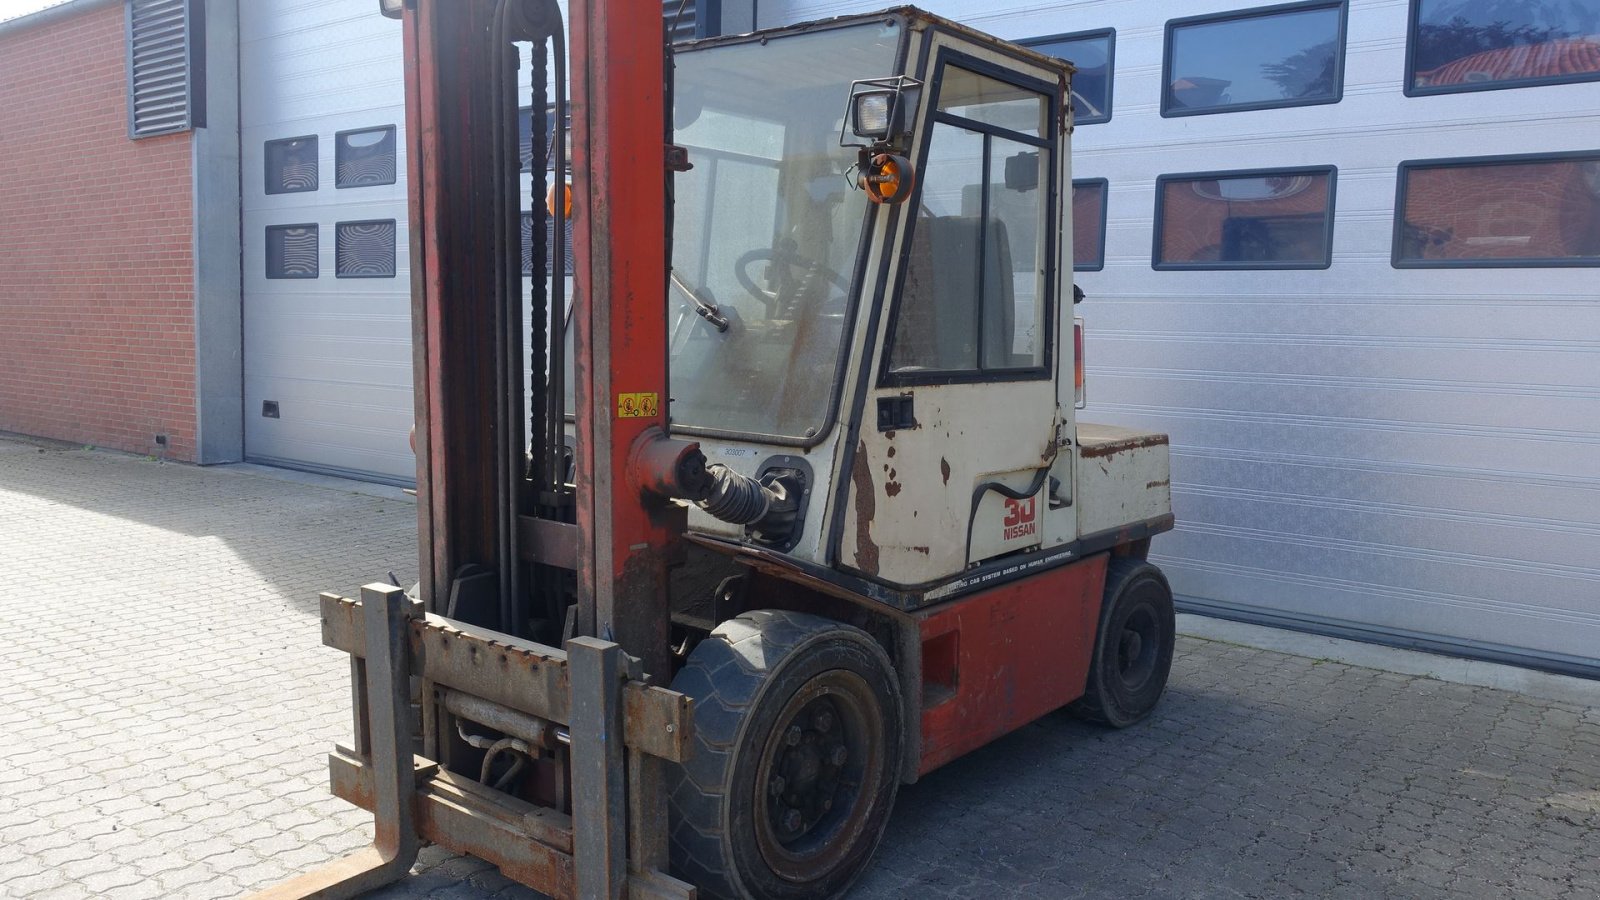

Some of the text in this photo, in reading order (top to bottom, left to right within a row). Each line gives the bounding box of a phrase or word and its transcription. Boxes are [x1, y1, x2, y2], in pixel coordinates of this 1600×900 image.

[1003, 522, 1036, 541] NISSAN
[982, 571, 1001, 582] SYSTEM
[1002, 566, 1019, 575] BASED
[1027, 559, 1044, 568] HUMAN
